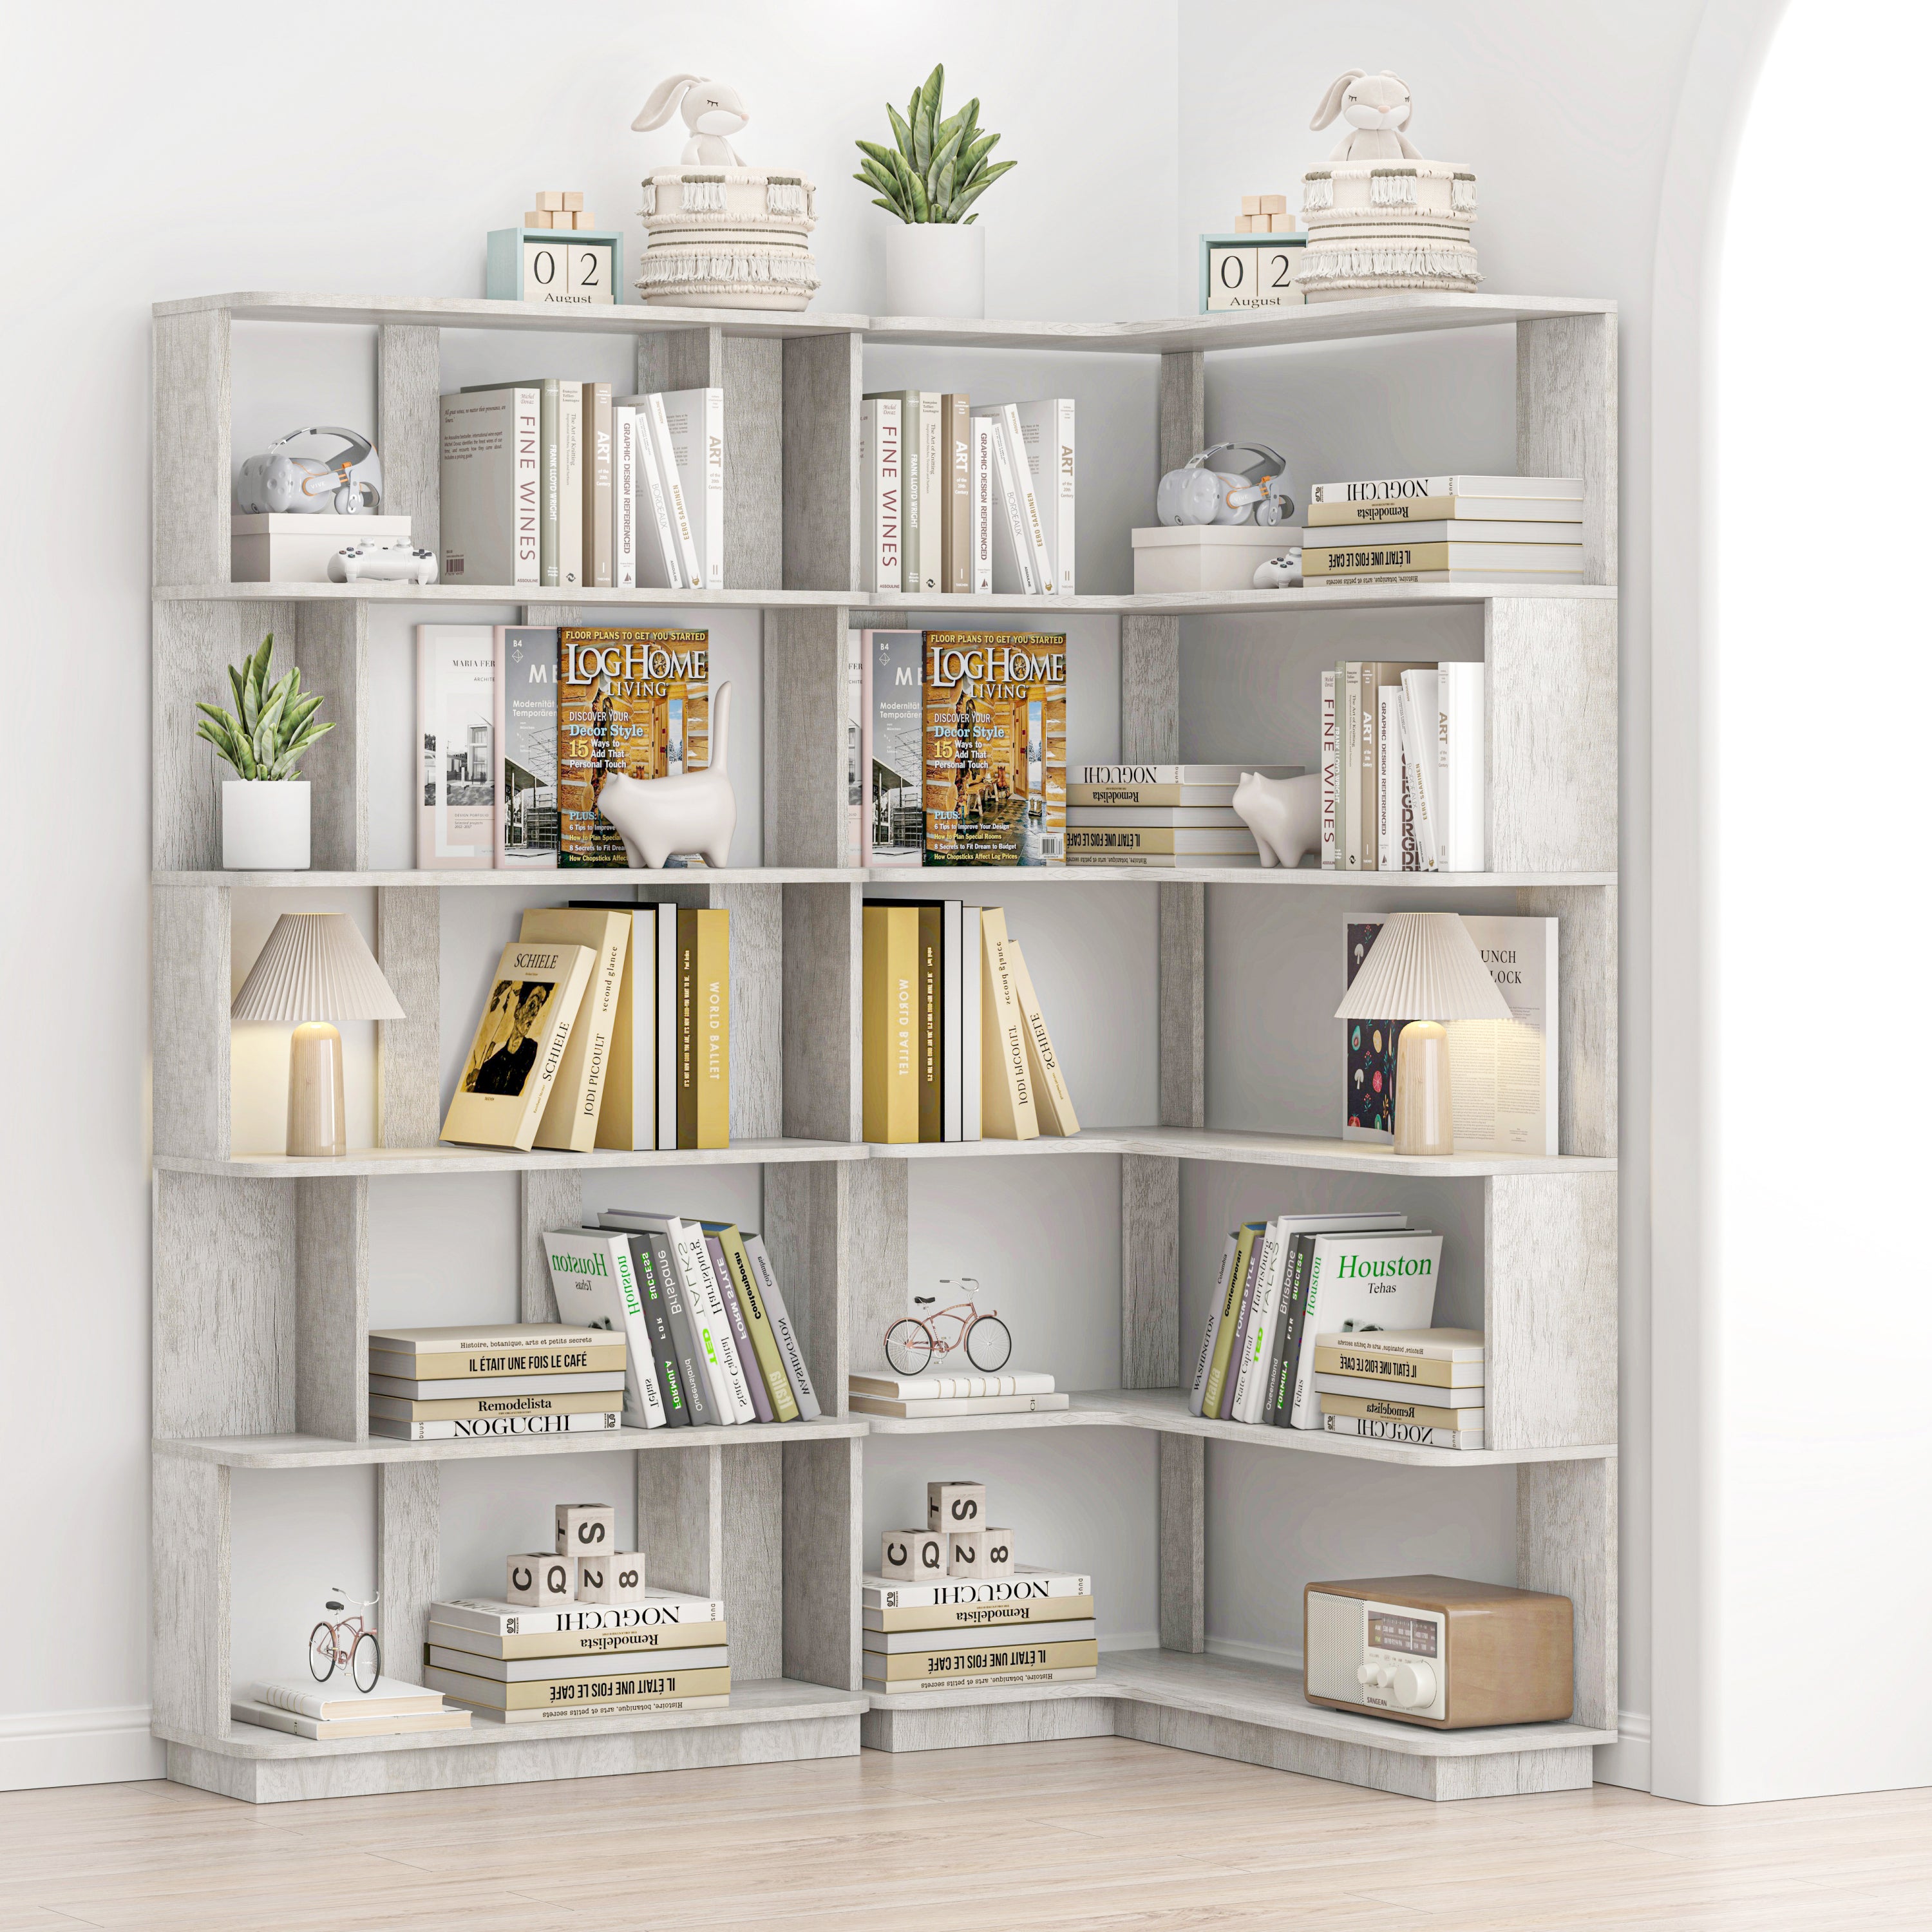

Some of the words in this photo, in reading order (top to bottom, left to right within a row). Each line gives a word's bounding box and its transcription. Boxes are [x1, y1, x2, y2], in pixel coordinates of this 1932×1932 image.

[544, 293, 592, 303] August
[1230, 298, 1282, 308] August
[520, 416, 535, 469] FINE
[598, 431, 609, 464] ART
[710, 436, 721, 467] ART
[882, 426, 896, 477] FINE
[956, 440, 967, 473] ART
[1062, 446, 1072, 476] ART
[310, 481, 326, 489] VIVE
[1347, 480, 1428, 500] NOGUCHI
[652, 484, 667, 529] BORDEAUX
[673, 485, 685, 520] SAARINEN
[1007, 492, 1022, 536] BORDEAUX
[1027, 493, 1039, 527] SAARINEN
[1357, 507, 1409, 520] Remodelista
[520, 480, 535, 560] WINES
[882, 489, 896, 566] WINES
[1329, 554, 1345, 570] CAFÉ
[1346, 553, 1353, 566] LE
[1355, 553, 1369, 566] FOIS
[1371, 552, 1384, 565] UNE
[1385, 551, 1403, 567] ÉTAIT
[1405, 551, 1410, 564] IL
[971, 684, 1026, 698] LIVING
[569, 712, 606, 721] DISCOVER
[609, 712, 629, 721] YOUR
[934, 714, 969, 723] DISCOVER
[972, 714, 990, 723] YOUR
[1324, 699, 1334, 751] FINE
[569, 724, 607, 736] Decor
[611, 724, 643, 739] Style
[934, 726, 971, 737] Decor
[973, 726, 1004, 740] Style
[569, 740, 589, 757] 15
[934, 741, 952, 758] 15
[1084, 767, 1157, 784] NOGUCHI
[1093, 792, 1139, 803] Remodelista
[1324, 764, 1334, 842] WINES
[515, 954, 559, 969] SCHIELE
[603, 980, 612, 1012] second
[609, 946, 618, 977] glance
[710, 981, 719, 1028] WORLD
[543, 1022, 569, 1081] SCHIELE
[589, 1034, 605, 1086] PICOULT
[710, 1036, 719, 1079] BALLET
[584, 1086, 596, 1117] JODI
[1252, 1238, 1273, 1313] Harrisburg
[1337, 1255, 1432, 1279] Houston
[1224, 1251, 1242, 1317] Contemporan
[1280, 1250, 1296, 1314] Brisbane
[1307, 1257, 1321, 1316] Houston
[1368, 1283, 1396, 1294] Tehas
[1236, 1307, 1245, 1338] FORM
[1244, 1257, 1255, 1297] STYLE
[1278, 1361, 1288, 1409] FORMULA
[1293, 1253, 1303, 1300] SUCCESS
[469, 1359, 477, 1372] IL
[480, 1356, 505, 1370] ÉTAIT
[508, 1356, 526, 1370] UNE
[529, 1356, 548, 1368] FOIS
[551, 1355, 561, 1367] LE
[564, 1352, 587, 1367] CAFÉ
[1194, 1314, 1215, 1390] WASHINGTON
[1236, 1377, 1245, 1405] State
[1242, 1336, 1253, 1374] Capital
[478, 1398, 552, 1412] Remodelista
[453, 1415, 570, 1437] NOGUCHI
[578, 1522, 605, 1544] S
[547, 1566, 566, 1595] Q
[619, 1569, 639, 1587] 8
[933, 1581, 1049, 1604] NOGUCHI
[556, 1606, 679, 1631] NOGUCHI
[956, 1607, 1029, 1623] Remodelista
[580, 1634, 659, 1649] Remodelista
[1367, 1697, 1387, 1706] SANGEAN
